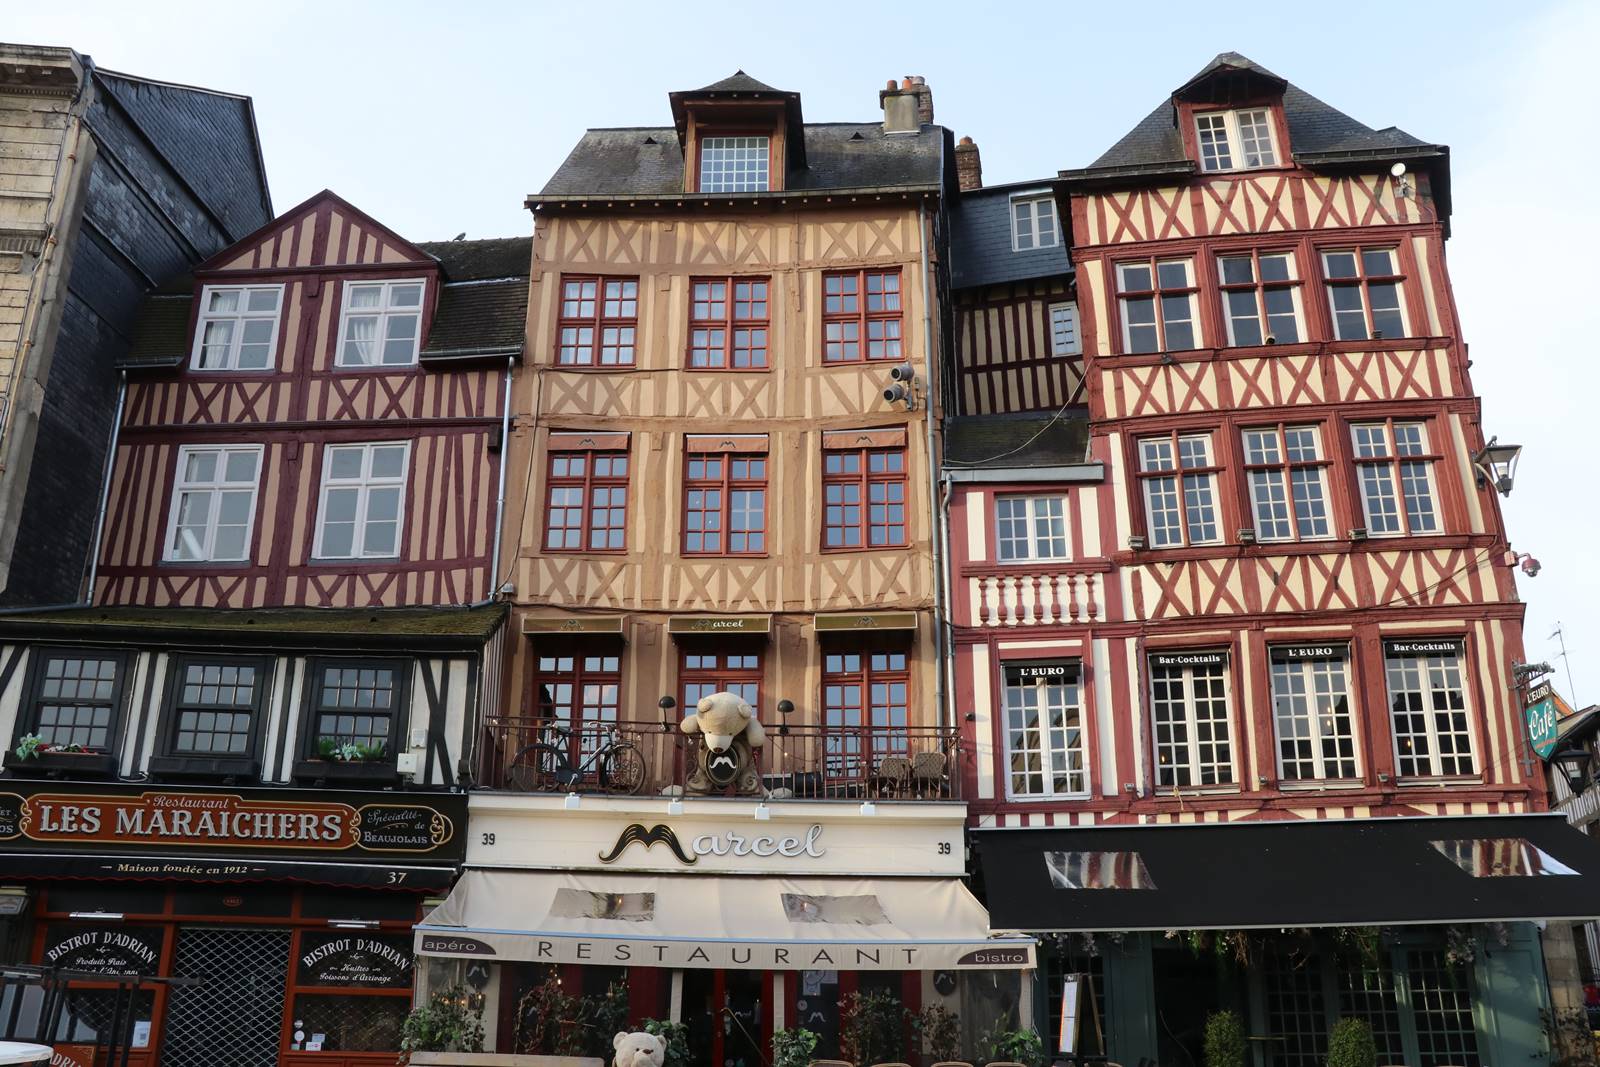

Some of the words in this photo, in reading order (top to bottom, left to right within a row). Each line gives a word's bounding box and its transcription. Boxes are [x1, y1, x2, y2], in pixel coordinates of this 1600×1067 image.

[1288, 647, 1333, 657] L'EURO
[1020, 667, 1065, 676] L'EURO
[1526, 684, 1549, 704] L'EURO
[1528, 702, 1553, 741] Café
[152, 794, 229, 809] Restaurant
[39, 805, 102, 834] LES
[114, 808, 343, 841] MARAICHERS
[414, 822, 425, 830] de
[363, 831, 428, 844] BEAUJOLAIS
[481, 833, 496, 846] 39
[937, 842, 951, 855] 39
[117, 863, 159, 873] Maison
[223, 866, 248, 874] 1912
[387, 872, 407, 884] 37
[47, 932, 98, 961] BISTROT
[103, 932, 157, 964] D'ADRIAN
[424, 939, 477, 953] apéro
[302, 938, 351, 968] BISTROT
[357, 938, 410, 970] D'ADRIAN
[537, 941, 918, 965] RESTAURANT
[975, 952, 1024, 963] bistro
[75, 956, 106, 966] Produits
[319, 972, 349, 982] Poissons
